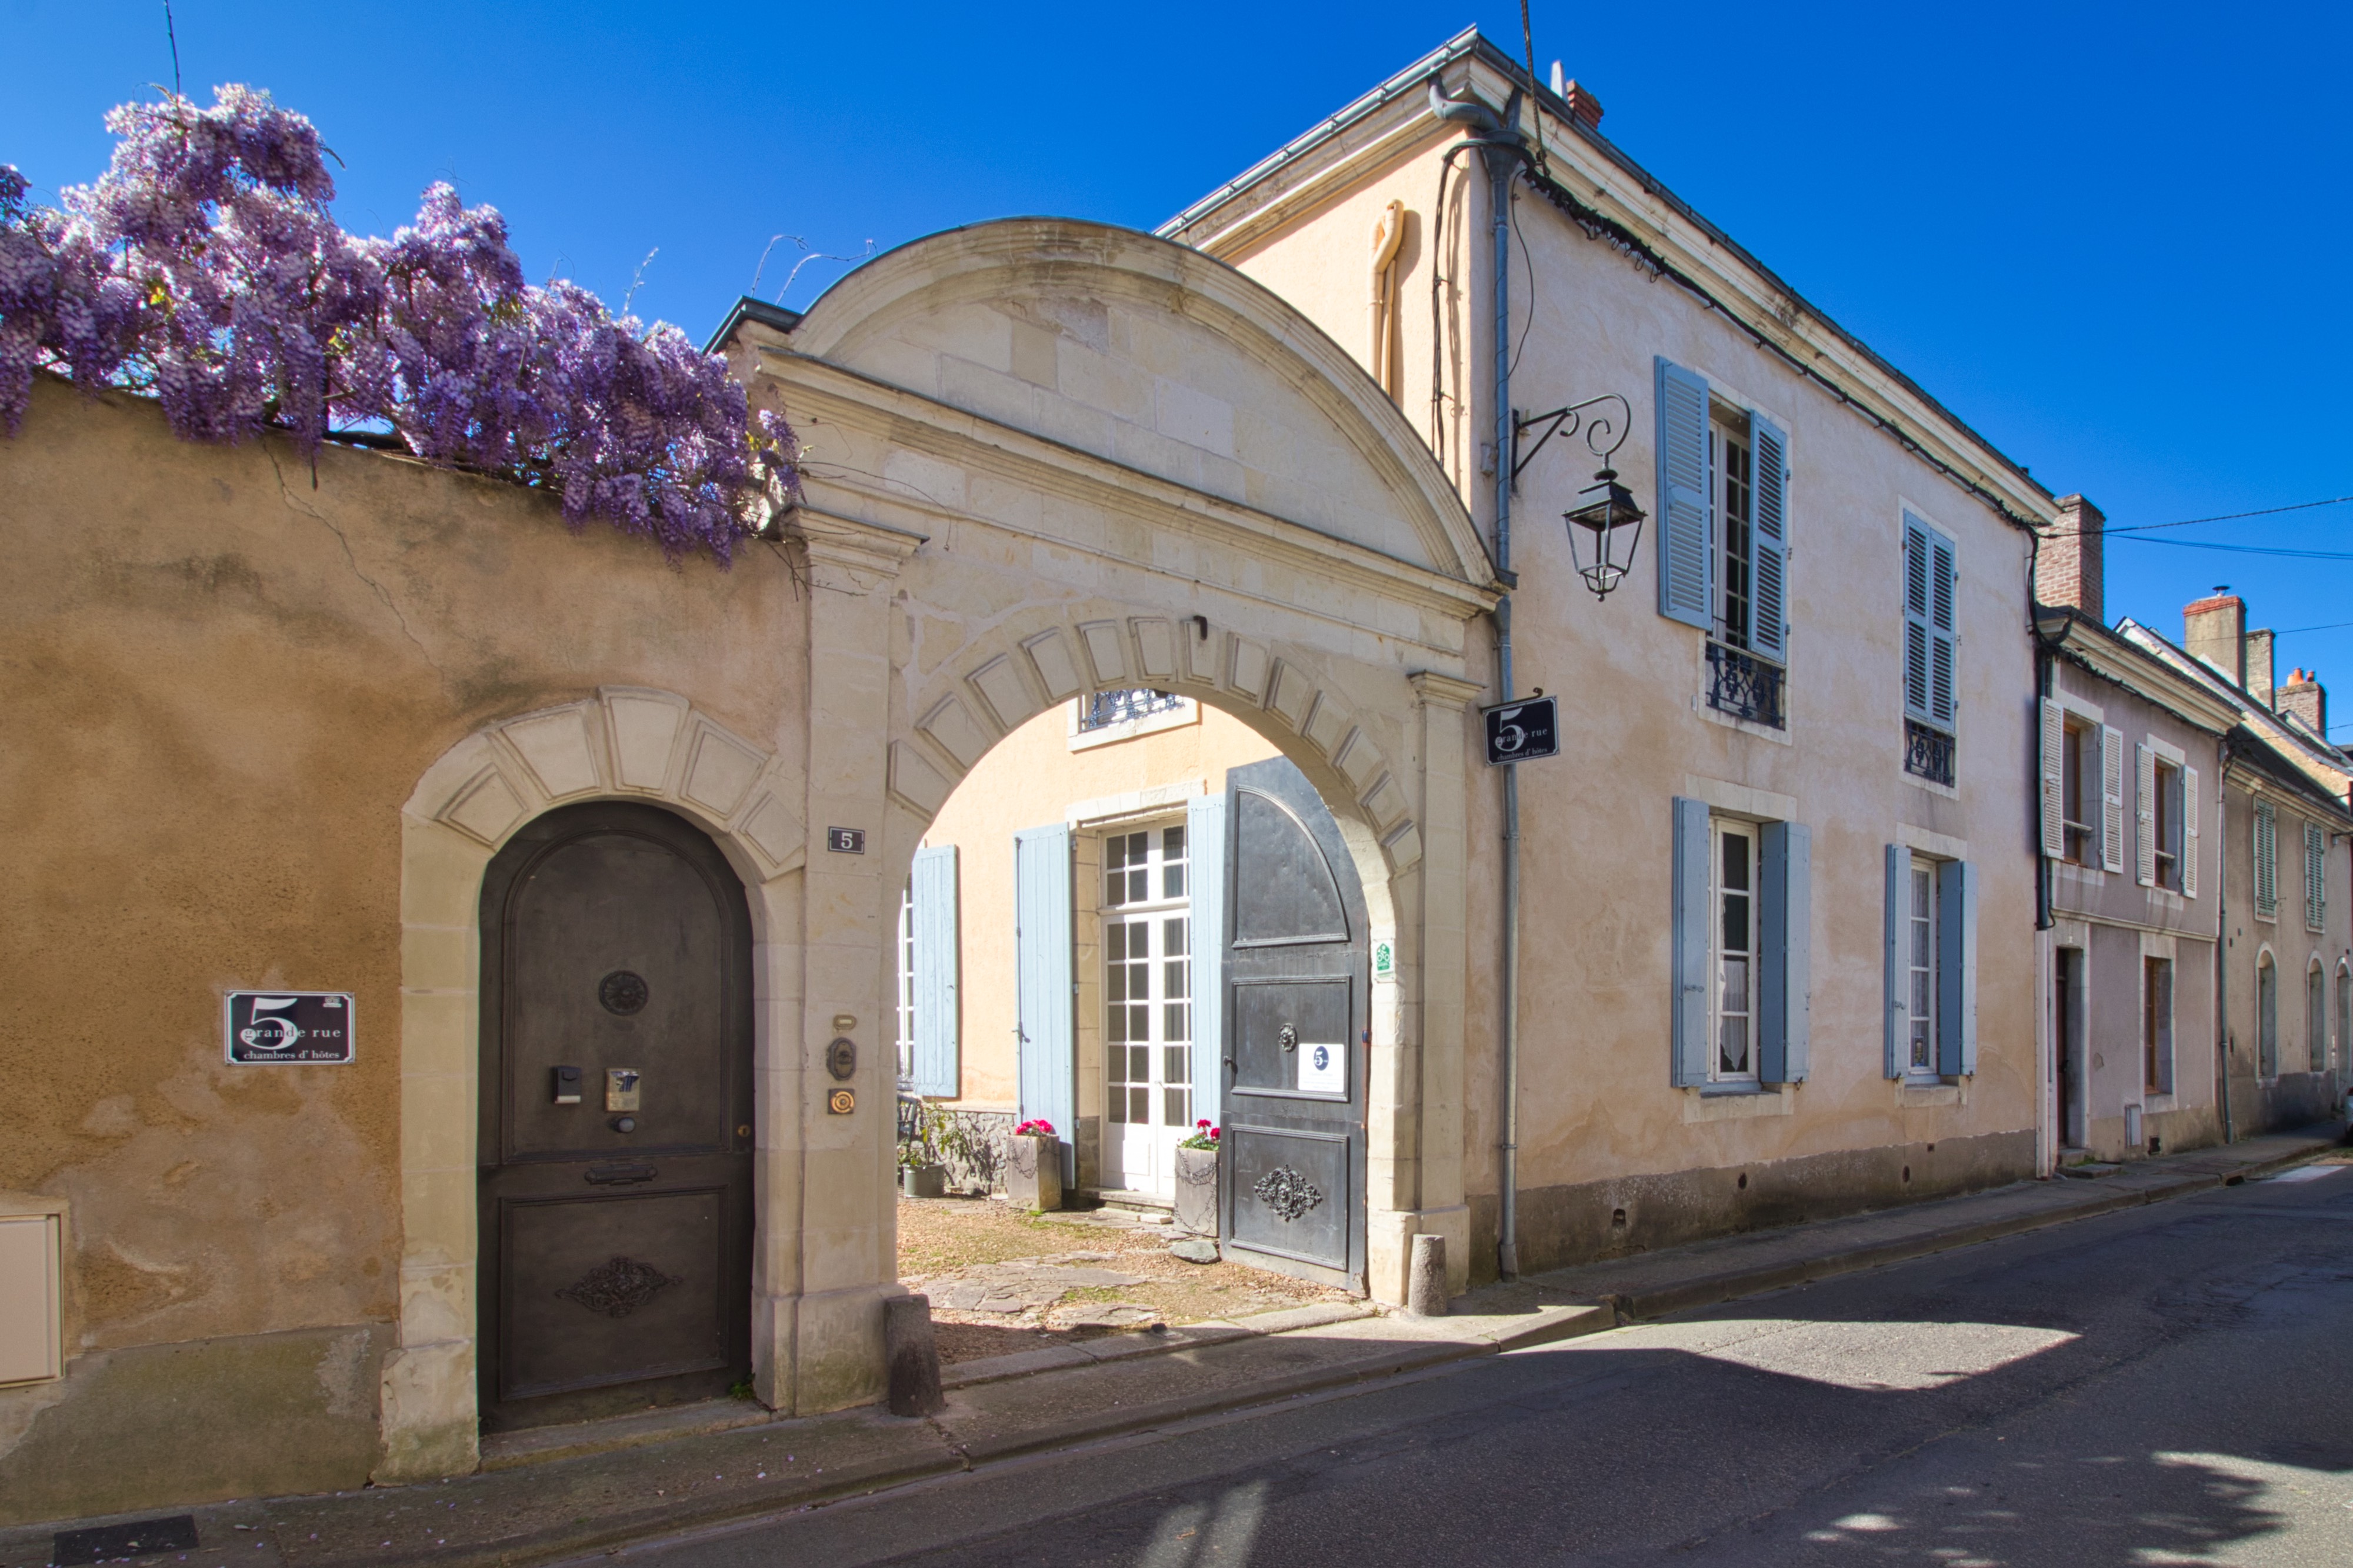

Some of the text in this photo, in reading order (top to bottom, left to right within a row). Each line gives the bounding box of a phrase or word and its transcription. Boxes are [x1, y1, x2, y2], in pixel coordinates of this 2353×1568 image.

[1495, 707, 1525, 752] 5
[1497, 728, 1548, 746] grande rue
[1497, 751, 1524, 761] chambres
[841, 832, 853, 849] 5
[240, 997, 298, 1050] 5
[244, 1026, 306, 1041] grande
[244, 1050, 295, 1059] chambres
[312, 1050, 340, 1059] hôtes
[1314, 1051, 1324, 1066] 5
